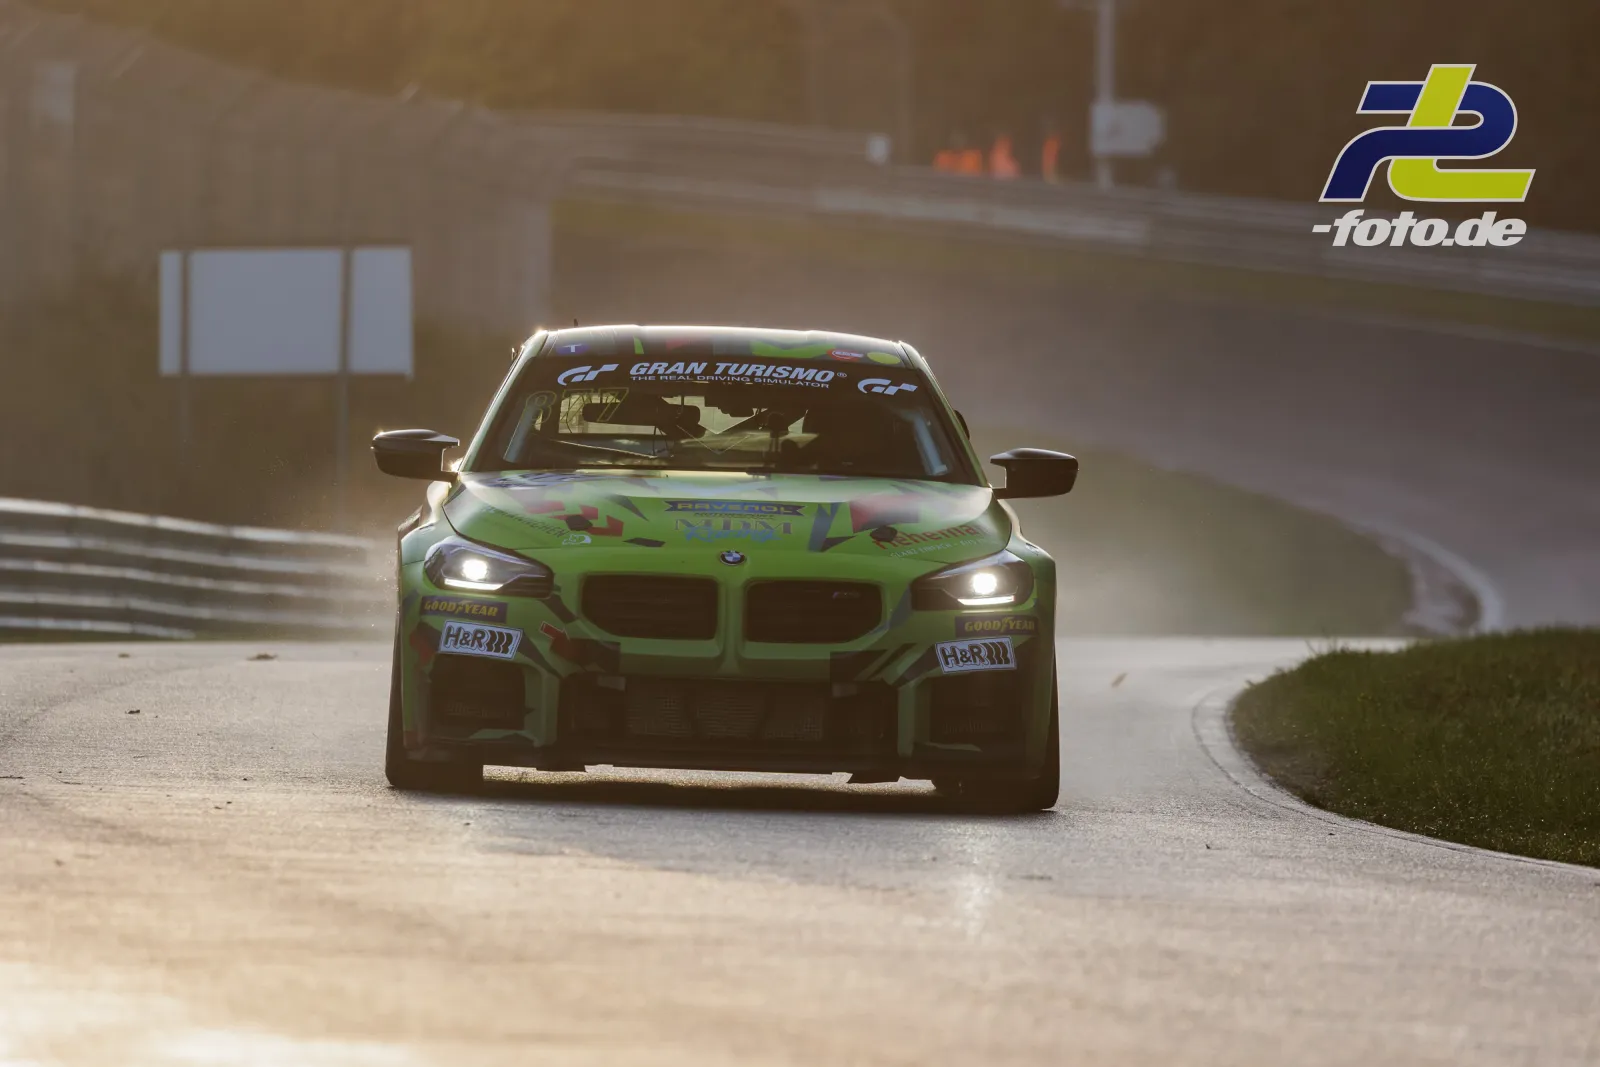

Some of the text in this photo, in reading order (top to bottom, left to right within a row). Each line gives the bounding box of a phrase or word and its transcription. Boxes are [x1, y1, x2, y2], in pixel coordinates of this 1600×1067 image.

[629, 362, 710, 375] GRAN
[754, 377, 830, 388] SIMULATOR
[677, 503, 793, 513] RAVENOL
[675, 518, 793, 535] MDM
[424, 600, 499, 616] GOODYEAR
[964, 617, 1035, 632] GOODYEAR
[444, 625, 488, 650] H&R
[940, 644, 986, 667] H&R
